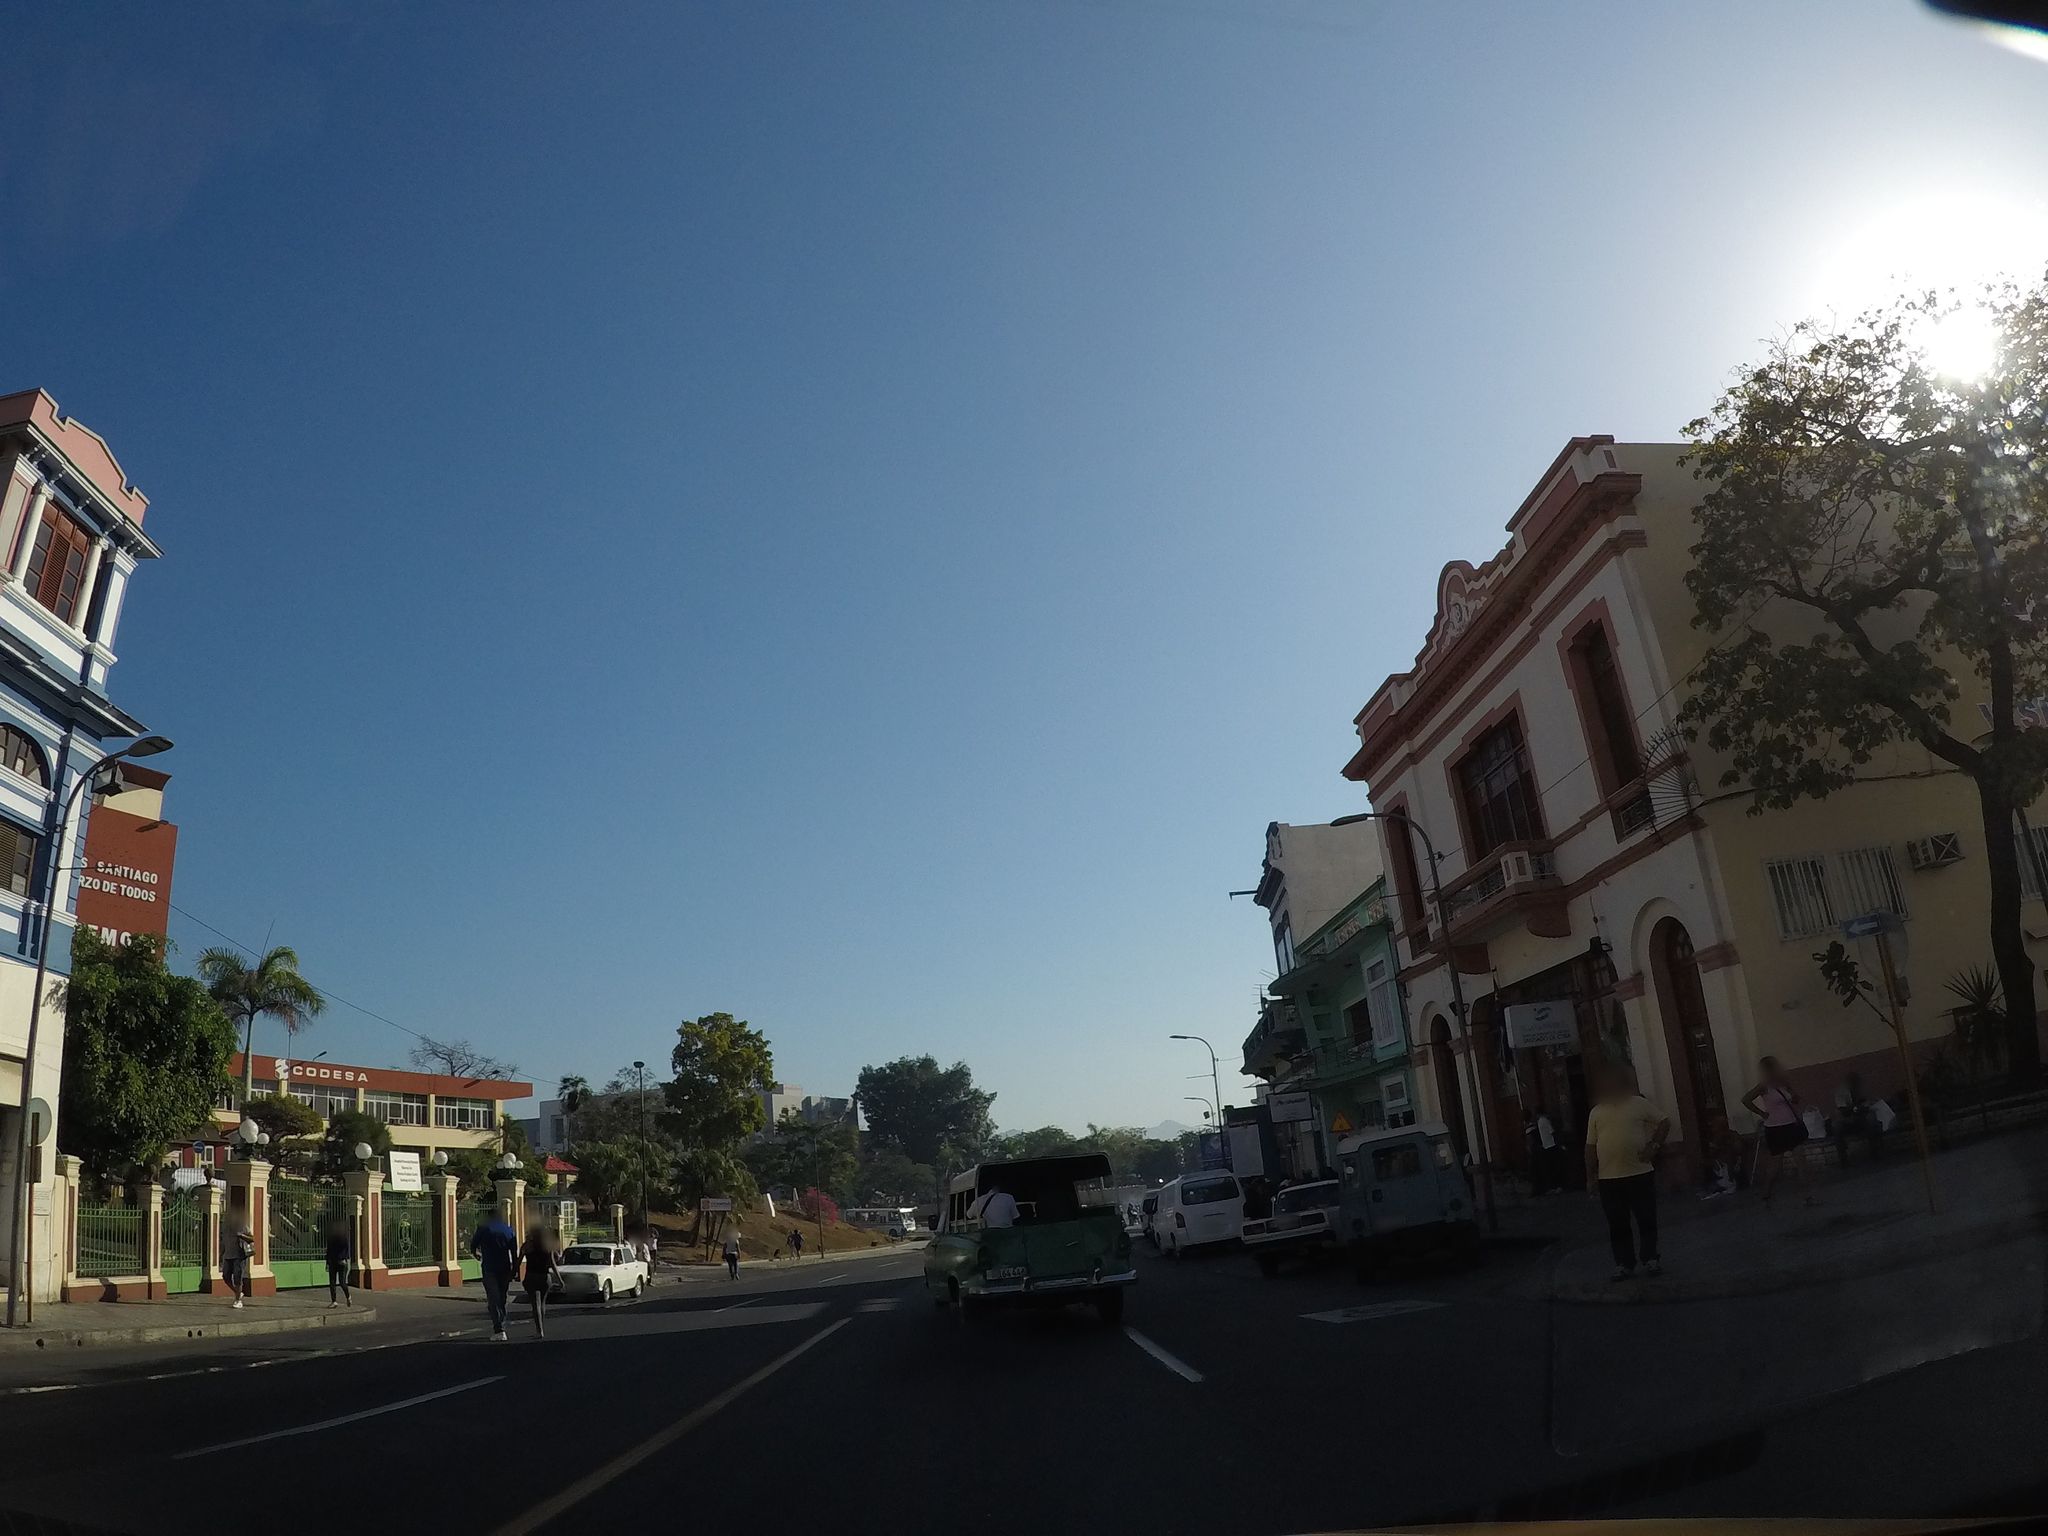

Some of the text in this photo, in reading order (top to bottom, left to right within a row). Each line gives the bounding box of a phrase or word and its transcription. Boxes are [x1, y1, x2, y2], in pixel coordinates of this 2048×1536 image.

[97, 861, 158, 885] SANTIAGO
[102, 880, 118, 894] DE
[120, 884, 156, 902] TODOS
[292, 1065, 368, 1082] CODESA
